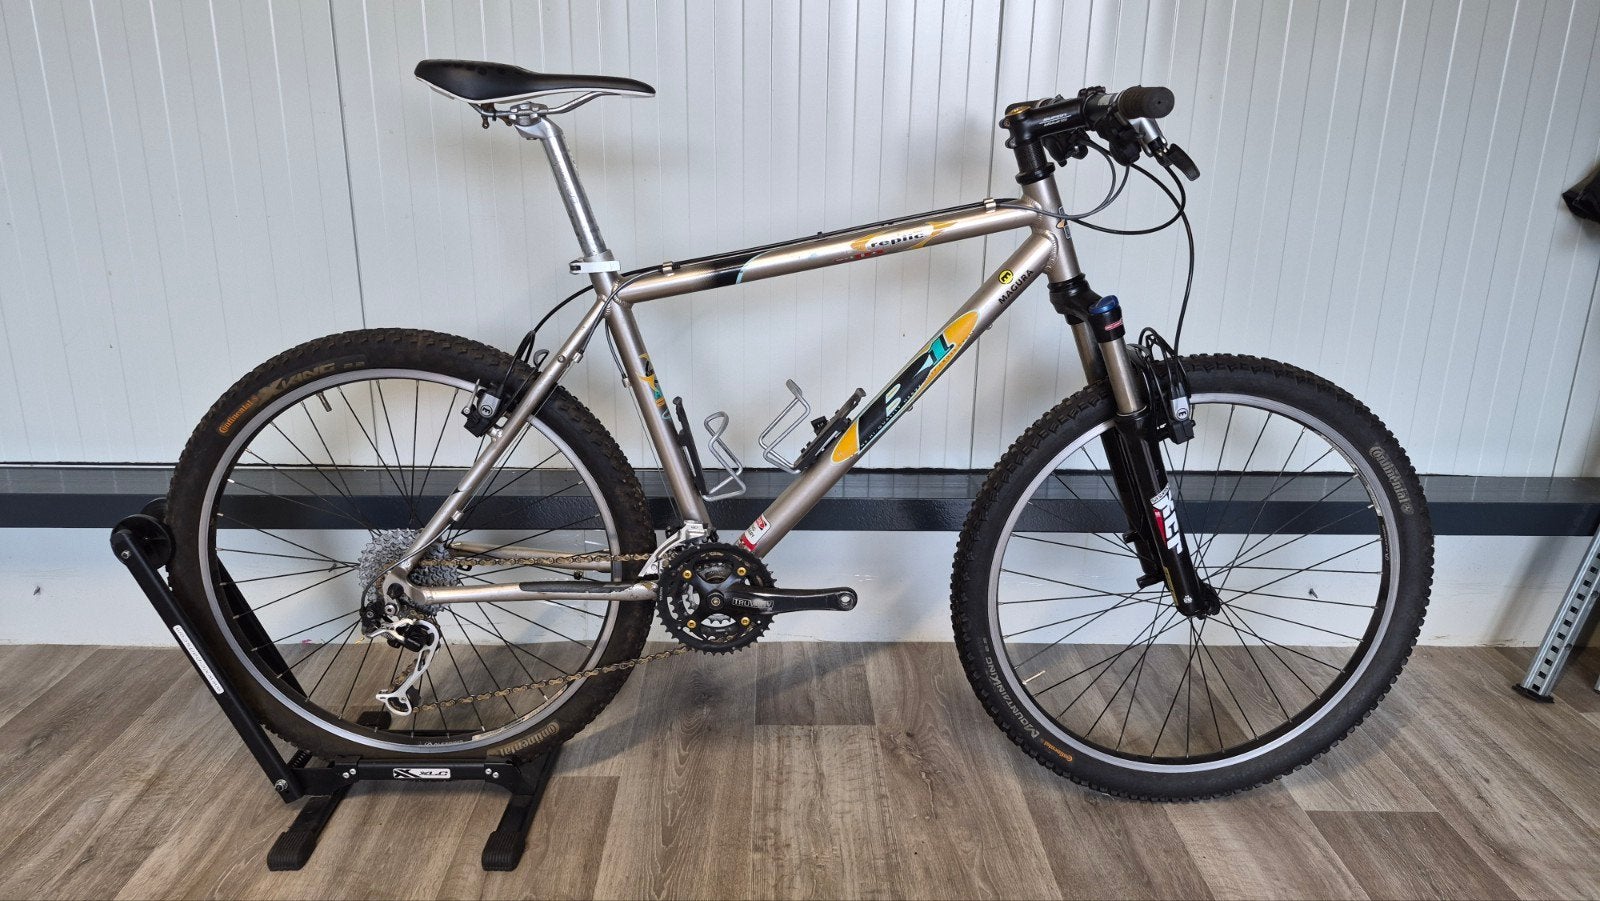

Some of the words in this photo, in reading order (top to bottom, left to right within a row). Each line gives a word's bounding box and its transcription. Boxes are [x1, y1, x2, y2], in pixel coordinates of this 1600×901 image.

[998, 269, 1034, 304] MAGURA
[218, 397, 254, 435] Continental
[1369, 446, 1411, 504] Continental
[500, 721, 560, 757] Continental
